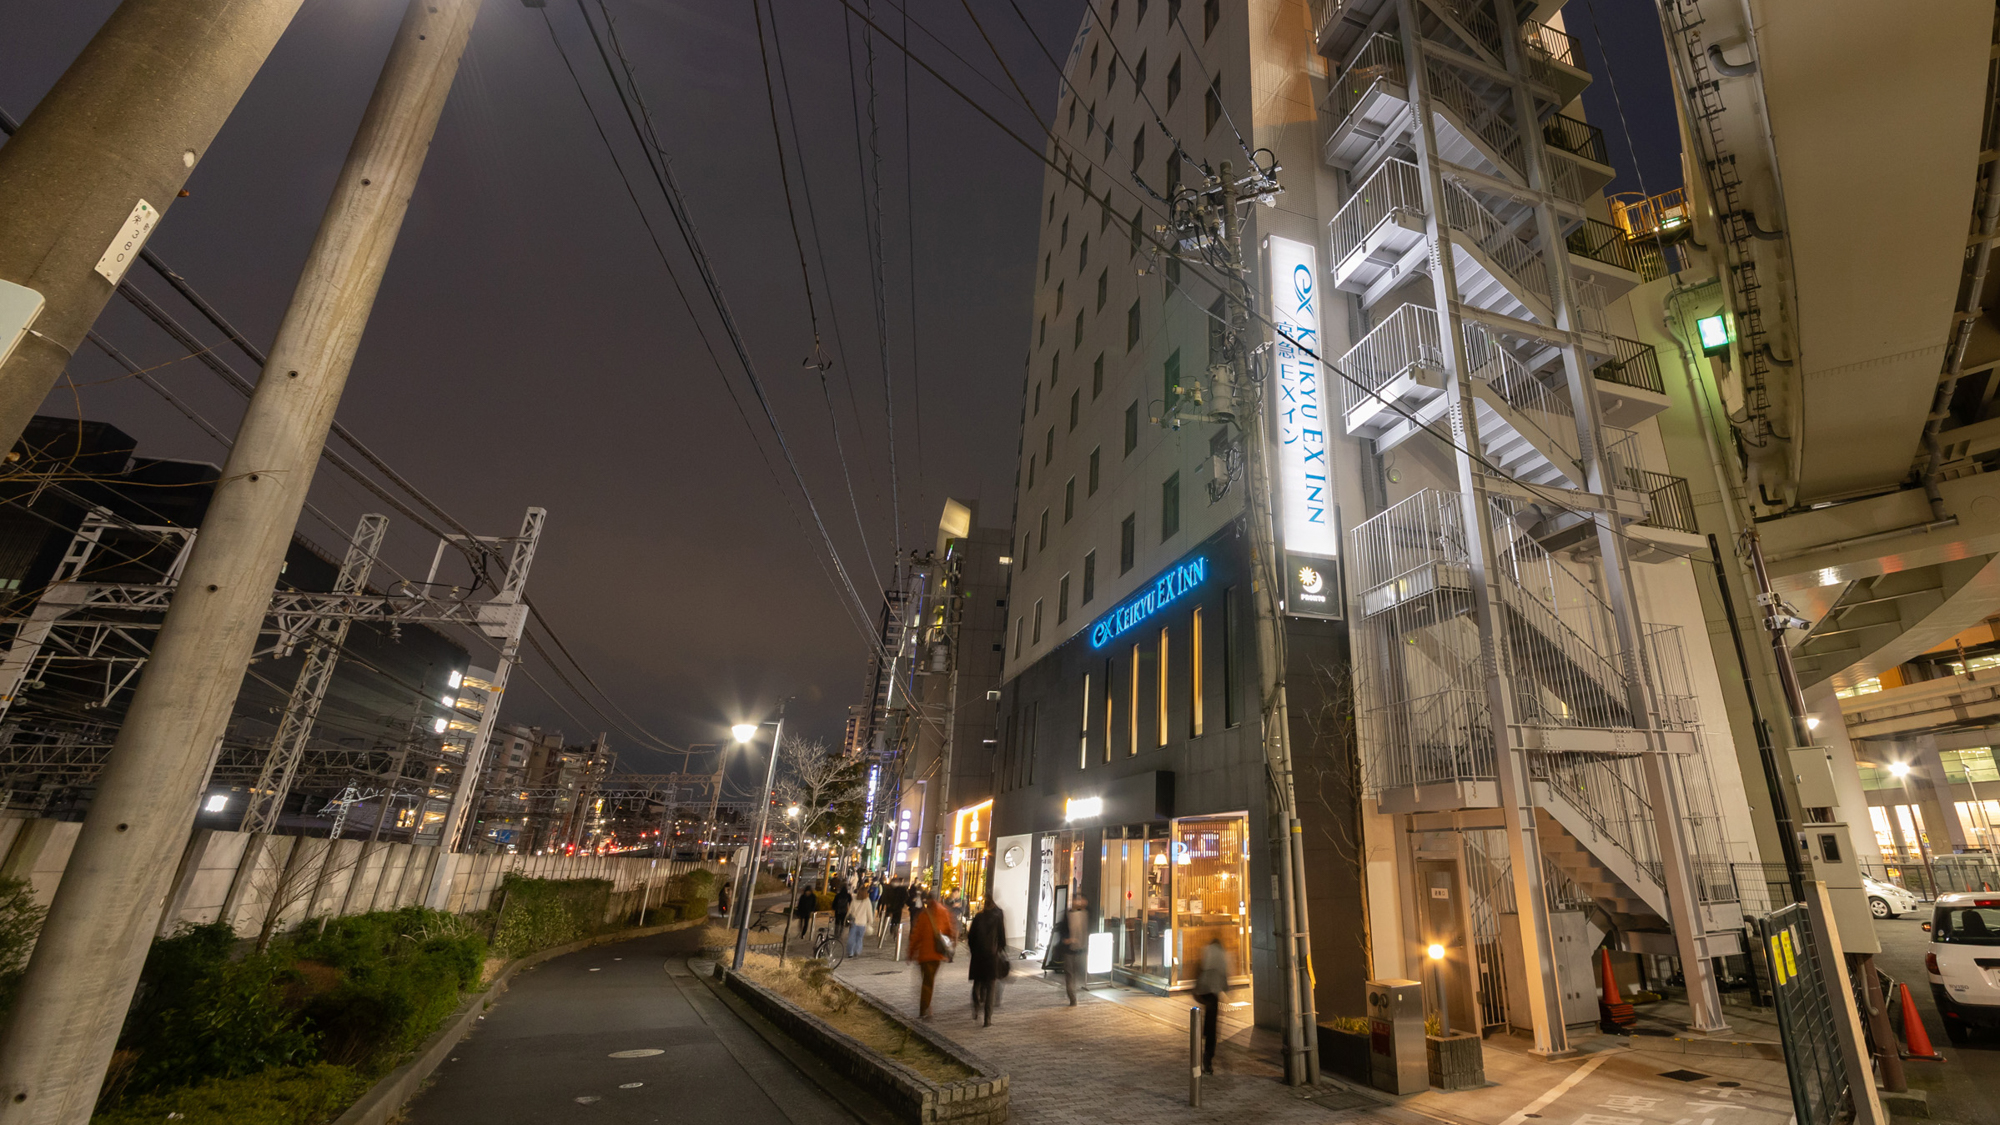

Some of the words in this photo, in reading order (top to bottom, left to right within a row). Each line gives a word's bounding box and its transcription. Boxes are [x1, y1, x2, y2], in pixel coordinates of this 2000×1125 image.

[1302, 426, 1325, 467] EX
[1305, 472, 1327, 526] INN
[1115, 590, 1156, 635] KEIKYU
[1156, 571, 1176, 609] EX
[1177, 557, 1204, 596] INN
